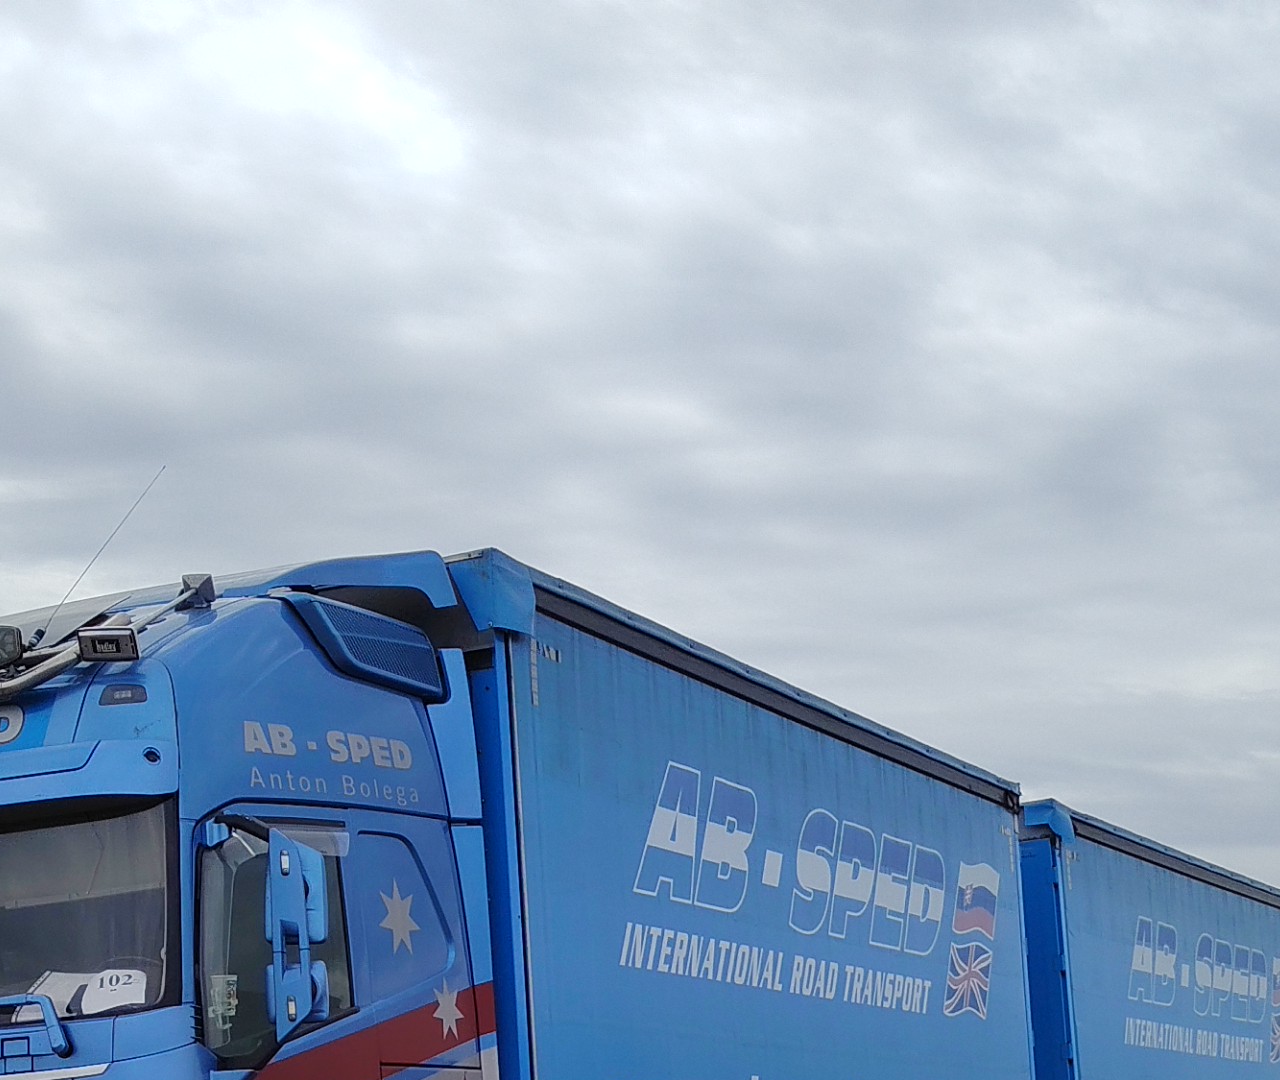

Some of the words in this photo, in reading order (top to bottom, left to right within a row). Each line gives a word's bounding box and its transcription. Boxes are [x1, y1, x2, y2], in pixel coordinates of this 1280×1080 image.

[243, 720, 297, 756] AB
[326, 730, 413, 770] SPED
[250, 766, 327, 794] Anton
[342, 774, 420, 806] Bolega
[632, 760, 758, 913] AB
[788, 807, 946, 956] SPED
[97, 974, 133, 989] 102
[619, 921, 784, 992] INTERNATIONAL
[789, 955, 839, 1000] ROAD
[843, 965, 932, 1015] TRANSPORT
[1127, 915, 1179, 1007] AB
[1193, 932, 1268, 1025] SPED
[1124, 1016, 1194, 1055] INTERNATIONAL
[1195, 1029, 1219, 1057] ROAD
[1220, 1033, 1264, 1063] TRANSPORT
